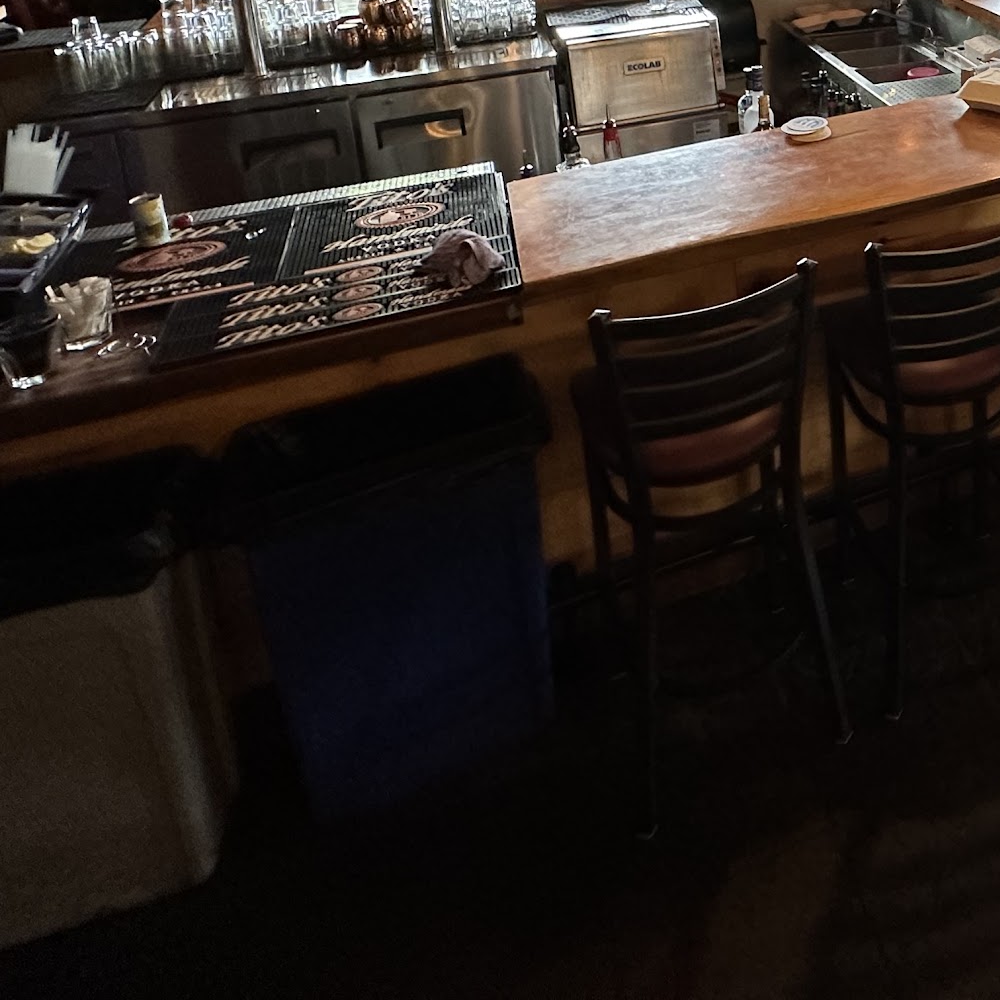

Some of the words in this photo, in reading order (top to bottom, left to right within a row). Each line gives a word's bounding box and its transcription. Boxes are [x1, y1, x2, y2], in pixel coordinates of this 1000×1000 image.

[627, 60, 662, 72] ECOLAB
[226, 277, 333, 309] Tito's
[218, 295, 329, 330] Tito's
[213, 315, 329, 351] Tito's
